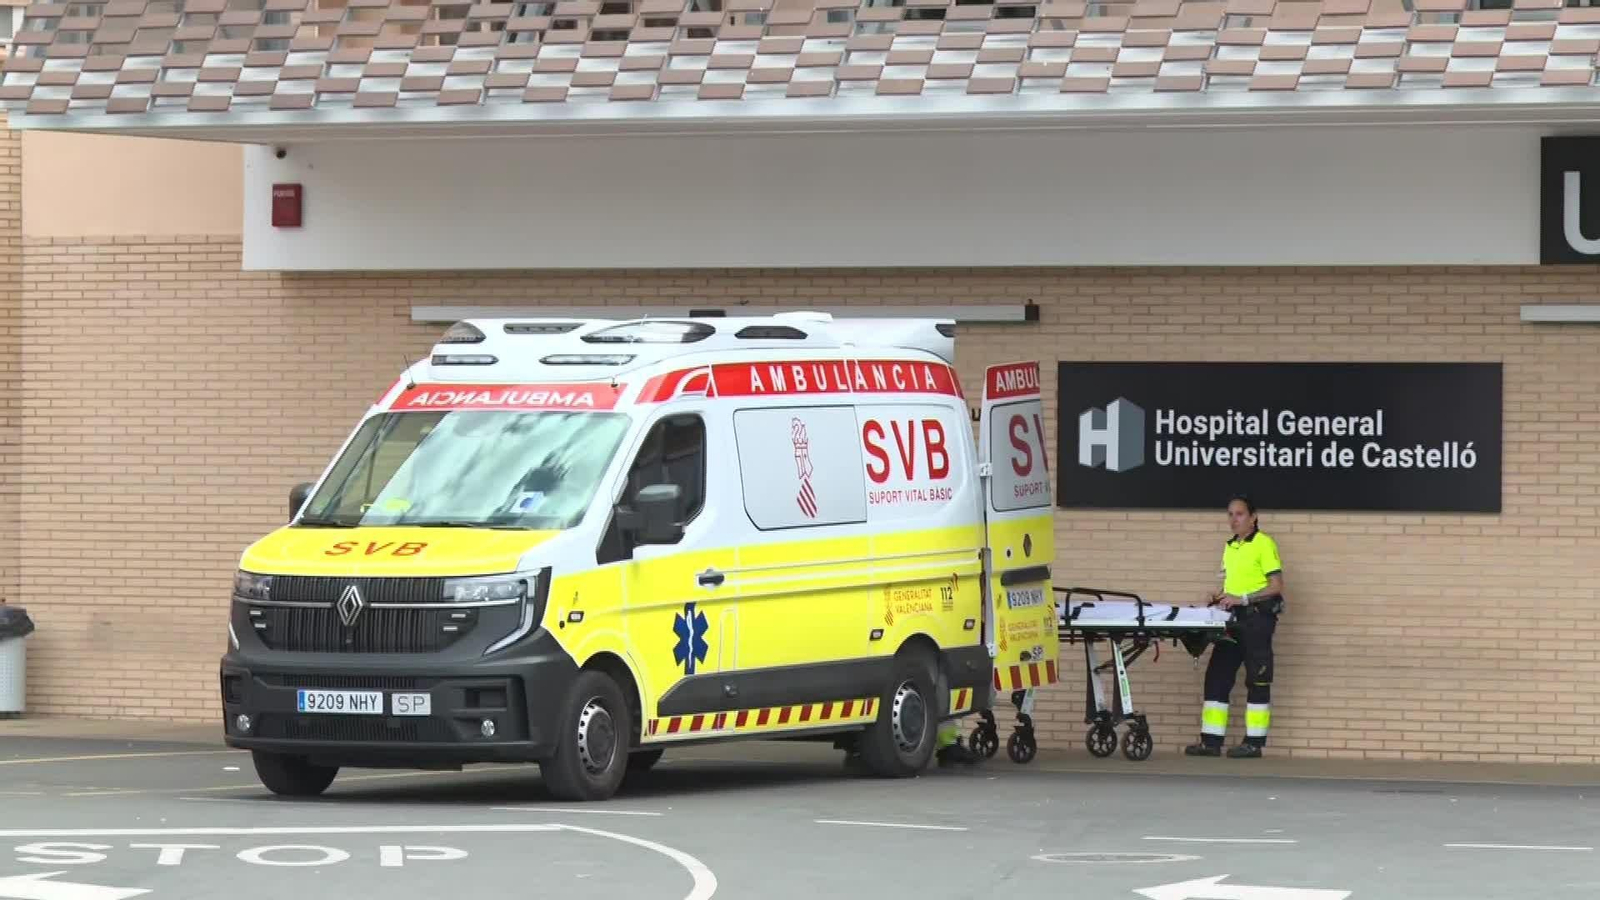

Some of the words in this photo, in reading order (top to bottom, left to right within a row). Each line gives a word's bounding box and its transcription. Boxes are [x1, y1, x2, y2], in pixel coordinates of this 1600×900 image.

[1155, 408, 1269, 441] Hospital
[1276, 408, 1383, 437] General
[862, 418, 950, 484] SVB
[1155, 440, 1314, 467] Universitari
[1320, 440, 1355, 468] de
[1361, 441, 1478, 469] Castelló
[869, 490, 902, 504] SUPORT
[905, 489, 928, 502] VITAL
[324, 541, 428, 556] SVB
[893, 587, 933, 602] GENERALITAT
[940, 586, 954, 600] 112
[894, 602, 934, 614] VALENCIANA
[307, 693, 344, 710] 9209
[349, 693, 377, 711] NHY
[397, 695, 425, 713] SP
[14, 841, 468, 867] STOP
